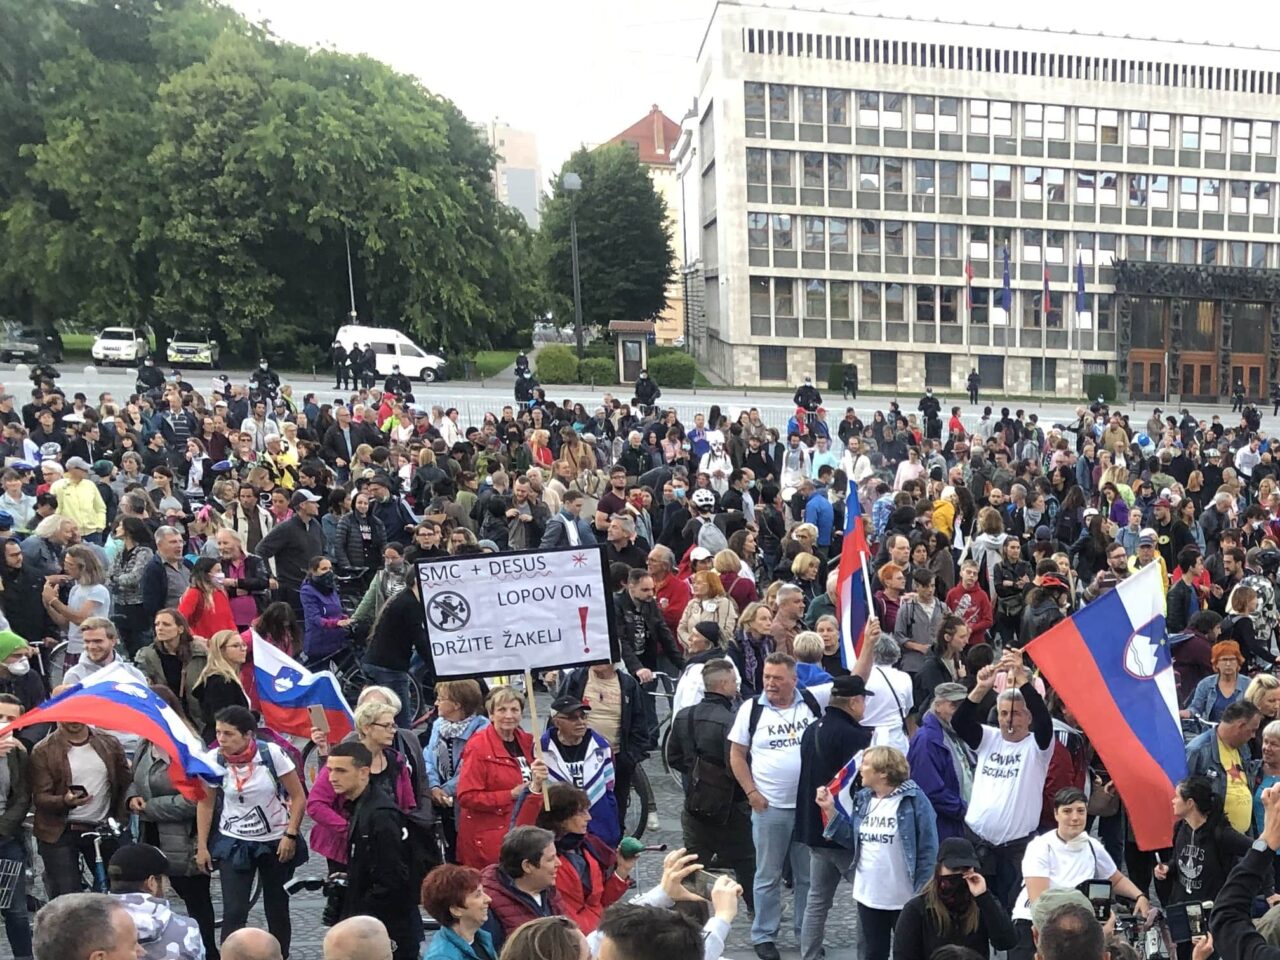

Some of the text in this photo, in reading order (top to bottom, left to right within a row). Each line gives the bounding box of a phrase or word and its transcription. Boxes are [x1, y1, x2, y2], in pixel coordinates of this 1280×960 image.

[420, 564, 461, 582] SMC
[489, 556, 546, 576] DESUS
[498, 584, 592, 606] LOPOVOM
[432, 634, 494, 657] DRŽITE
[503, 628, 562, 649] ŽAKELJ
[769, 736, 802, 750] SOCIAL
[982, 765, 1019, 779] SOCIALIST
[862, 816, 897, 828] AVIAR
[860, 832, 895, 845] OCIALIST
